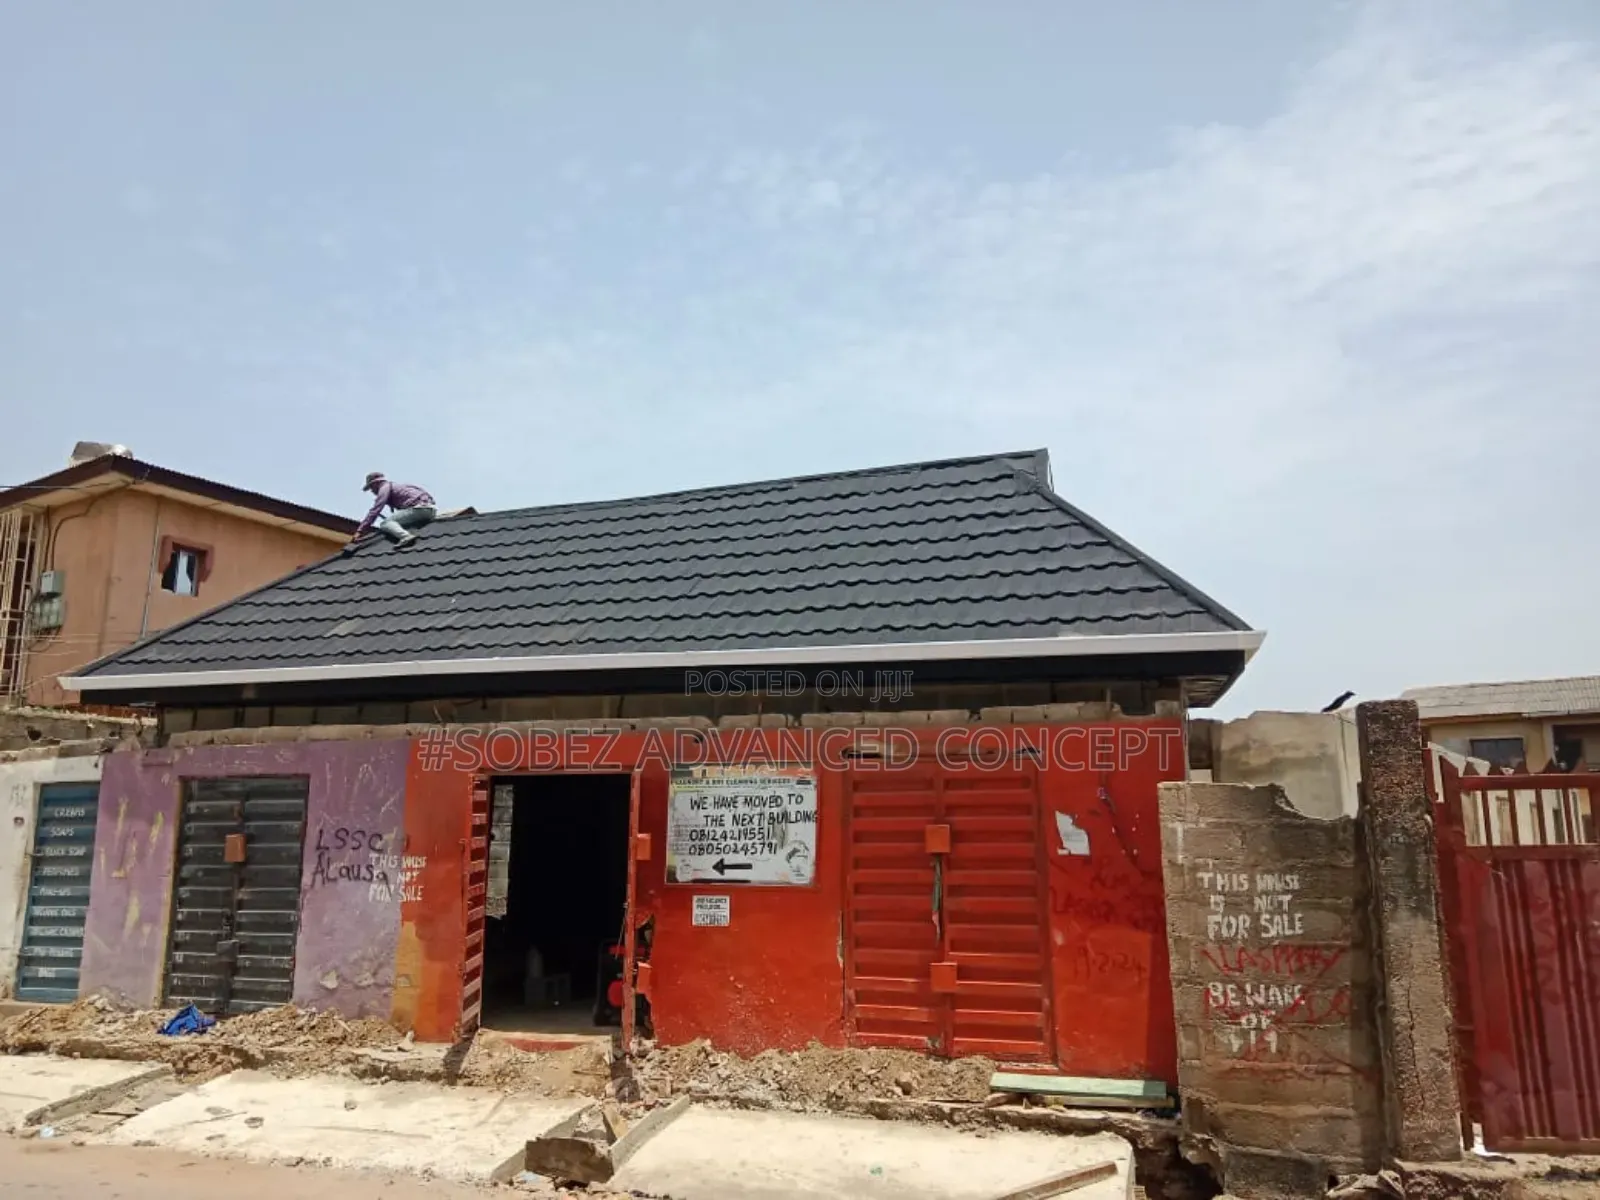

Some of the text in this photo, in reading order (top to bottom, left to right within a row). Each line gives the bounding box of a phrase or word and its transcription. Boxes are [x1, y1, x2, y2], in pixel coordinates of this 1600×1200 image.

[690, 793, 804, 811] WE HAVE MOVED TO
[703, 810, 819, 827] THE NEXT BUILDING
[1196, 872, 1250, 893] THIS
[1253, 894, 1293, 913] NOT
[1207, 913, 1305, 941] FOR SALE
